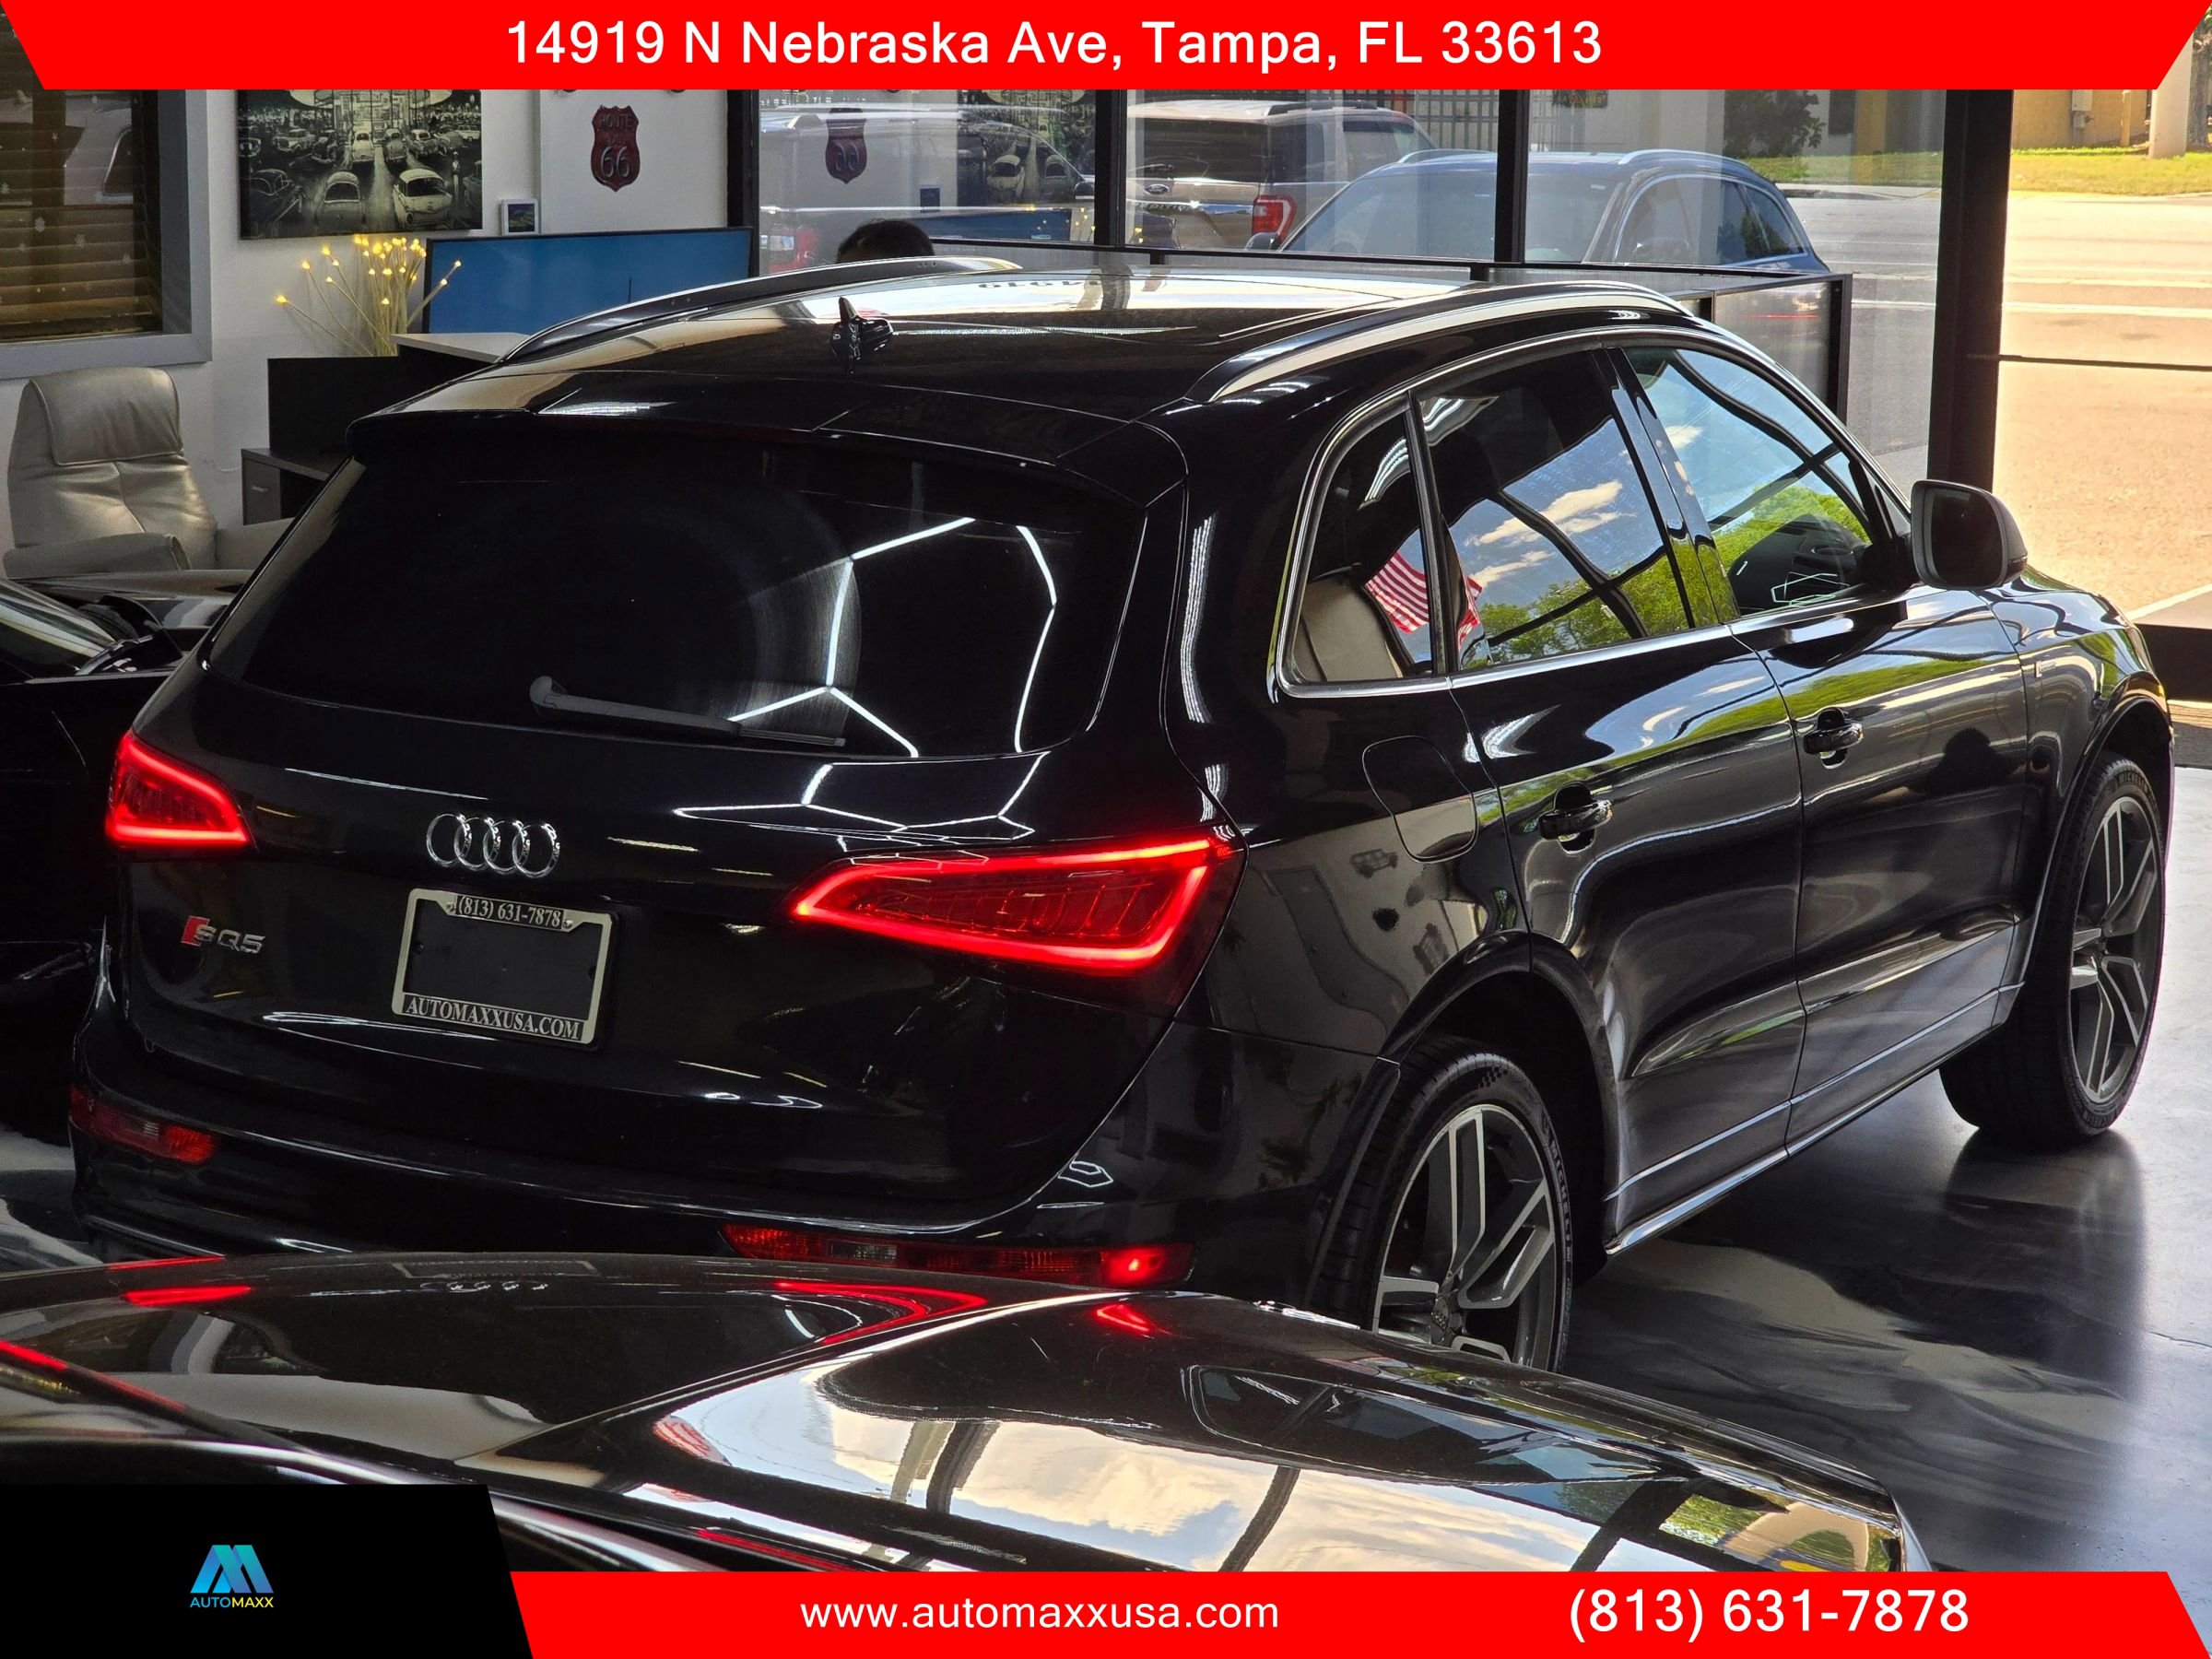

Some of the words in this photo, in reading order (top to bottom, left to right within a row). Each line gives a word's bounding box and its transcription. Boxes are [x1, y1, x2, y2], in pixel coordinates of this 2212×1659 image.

[601, 146, 629, 178] 66
[458, 895, 494, 920] (813)
[497, 902, 561, 927] 631-7878
[193, 924, 266, 954] SQ5
[406, 996, 581, 1041] AUTOMAXXUSA.COM
